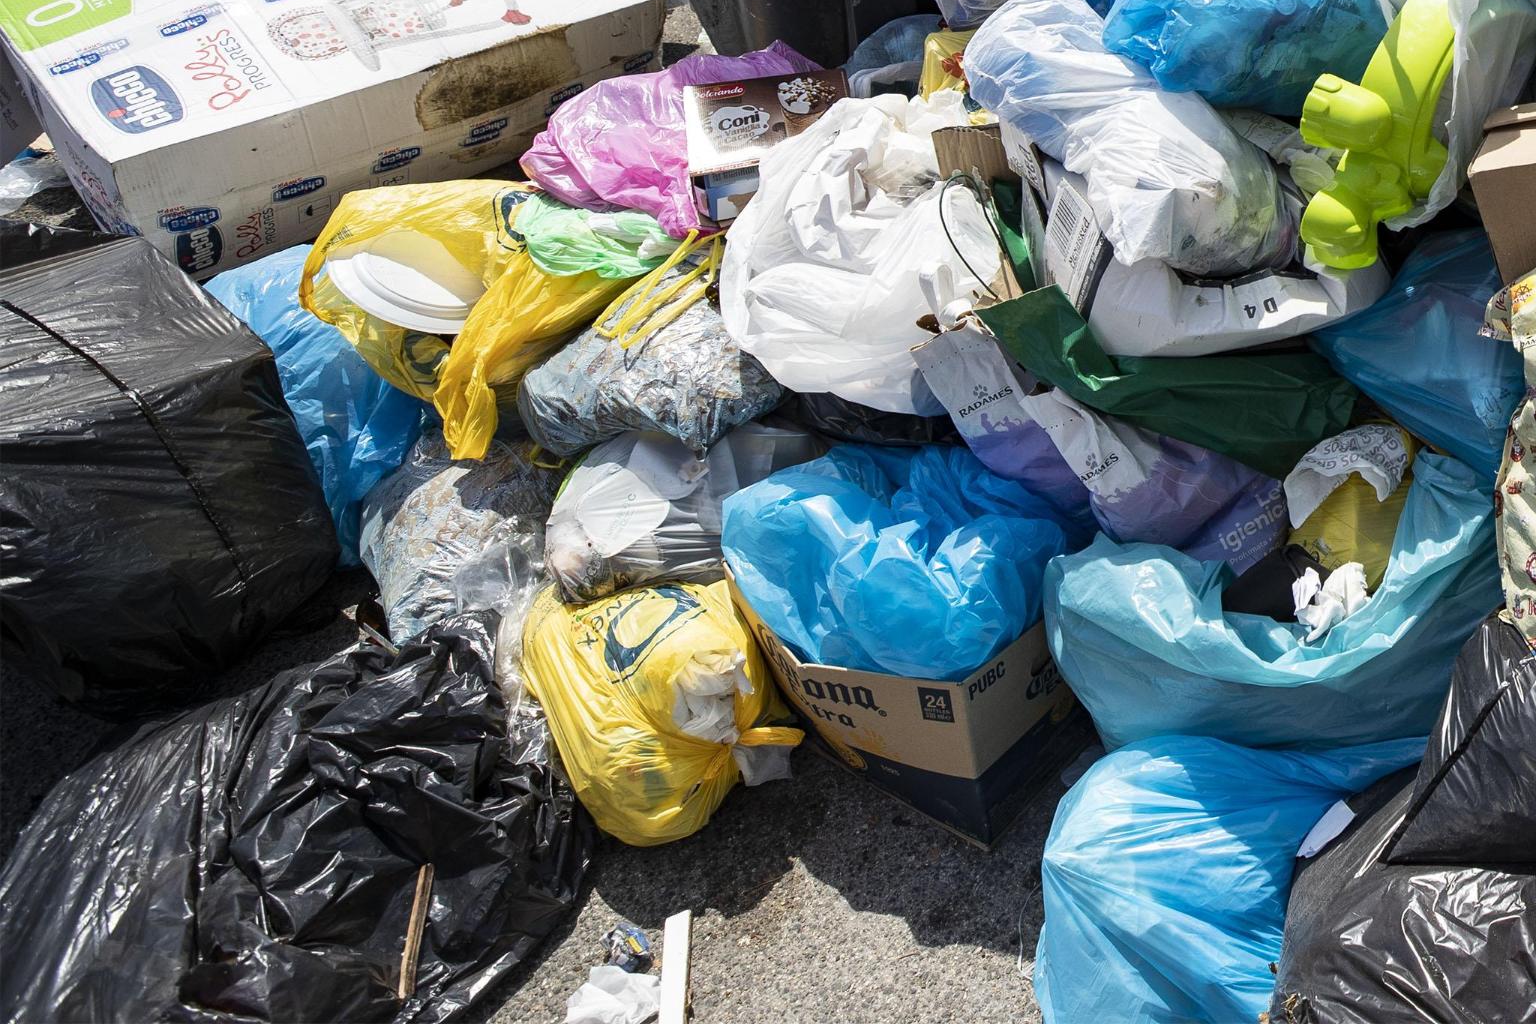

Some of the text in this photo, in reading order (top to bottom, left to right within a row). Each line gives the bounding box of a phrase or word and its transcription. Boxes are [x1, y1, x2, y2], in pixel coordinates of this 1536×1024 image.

[108, 71, 174, 128] chicco
[718, 111, 760, 131] Coni
[724, 124, 761, 137] Vaniglia
[725, 132, 755, 144] Cacao
[187, 228, 214, 272] chicco
[959, 385, 1013, 418] RADAMES
[1079, 453, 1120, 484] ADAMES
[968, 661, 1006, 701] PUBC
[925, 694, 946, 709] 24
